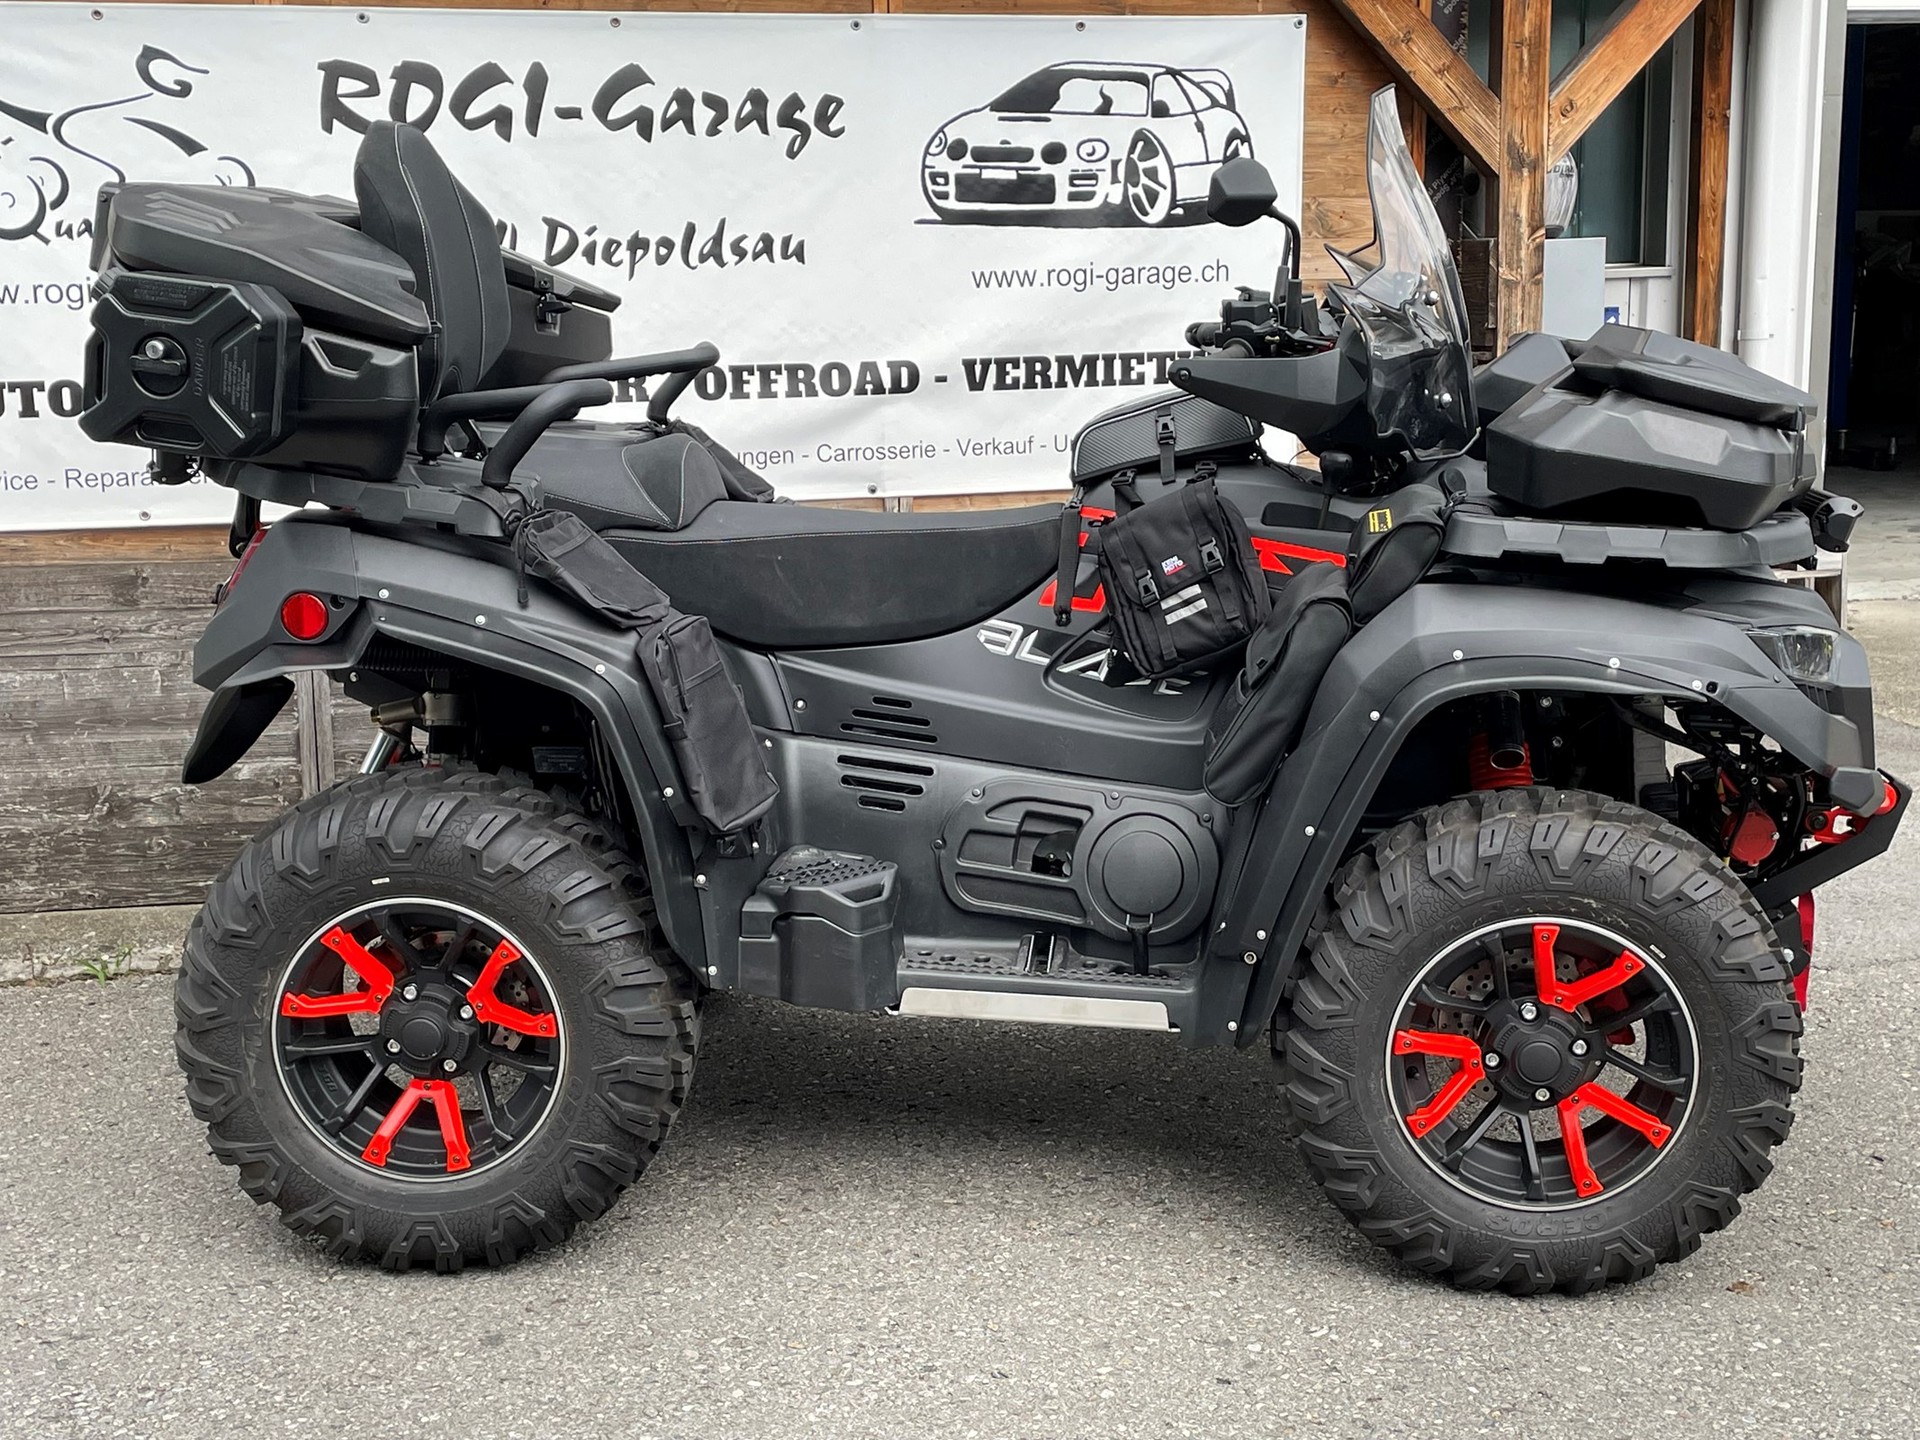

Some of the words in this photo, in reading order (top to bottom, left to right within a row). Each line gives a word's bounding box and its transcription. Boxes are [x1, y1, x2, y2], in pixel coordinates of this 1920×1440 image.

[317, 58, 847, 160] ROGI-Garage
[541, 213, 806, 281] Diepoldsau
[971, 258, 1230, 293] www.rogi-garage.ch
[694, 359, 922, 401] OFFROAD
[961, 350, 1206, 393] VERMIET
[816, 438, 937, 464] Carrosserie
[956, 435, 1035, 458] Verkauf
